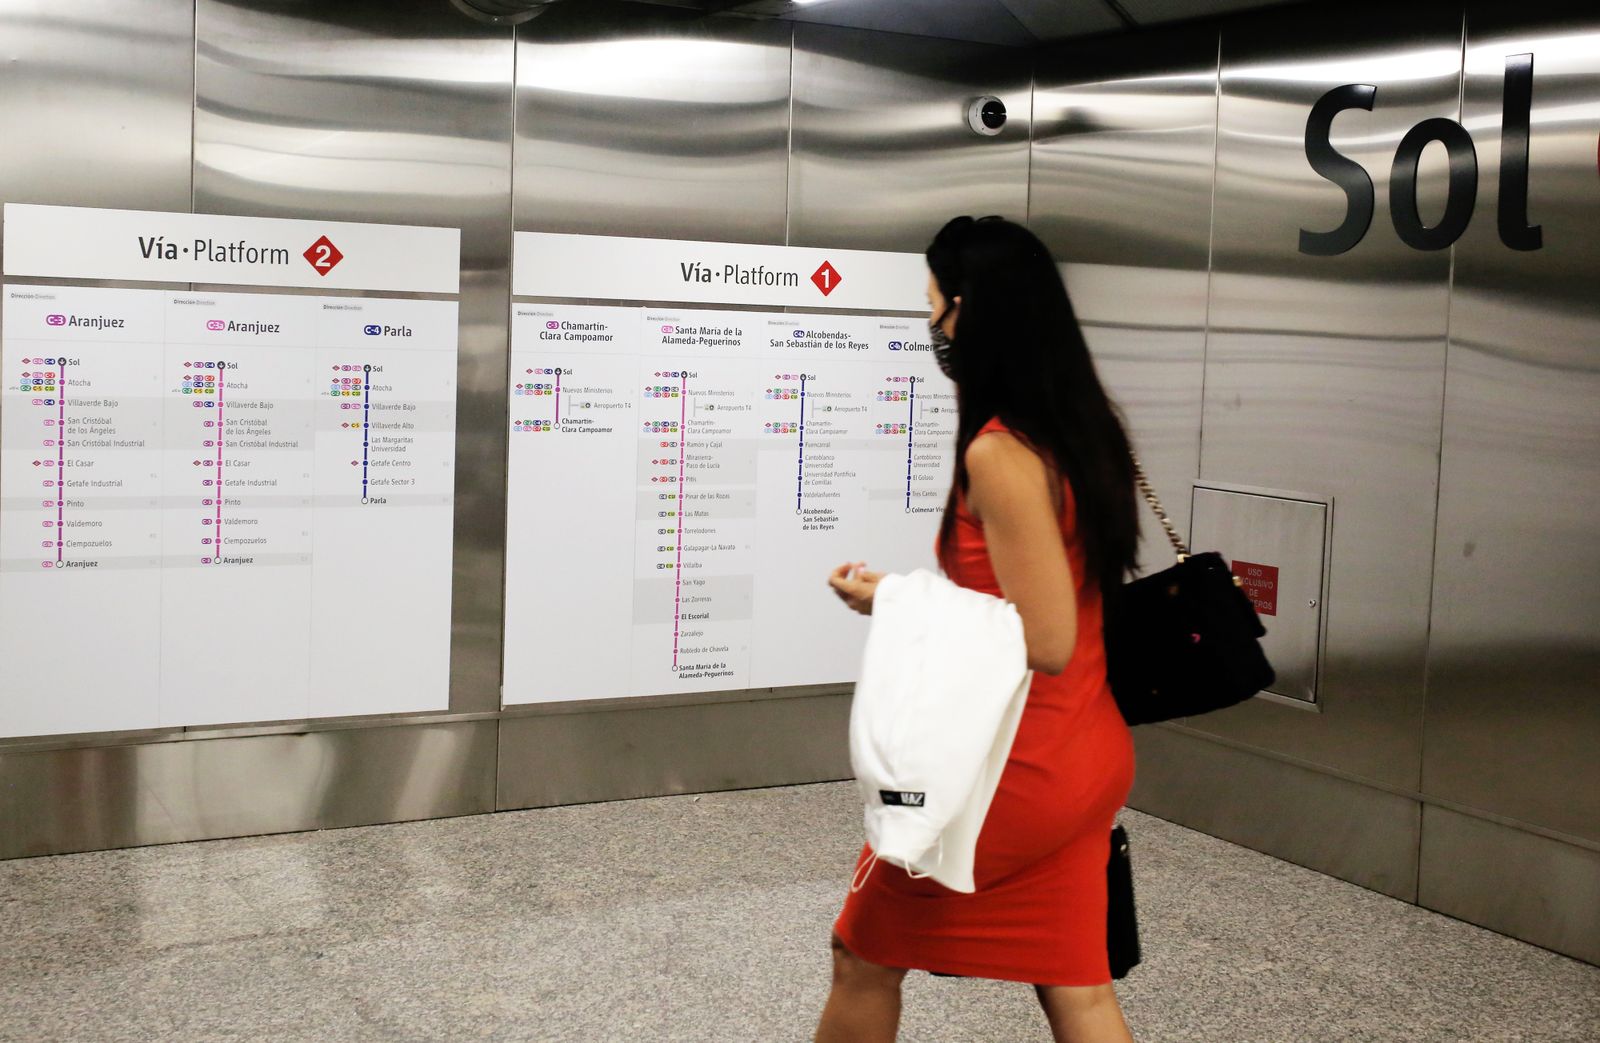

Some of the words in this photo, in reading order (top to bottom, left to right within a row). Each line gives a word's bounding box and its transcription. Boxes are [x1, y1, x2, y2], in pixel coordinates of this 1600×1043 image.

[1299, 53, 1543, 256] Sol
[194, 239, 290, 265] Platform
[316, 245, 332, 267] 2
[724, 266, 799, 287] Platform
[820, 269, 831, 288] 1
[69, 315, 124, 330] Aranjuez
[227, 320, 280, 335] Aranjuez
[384, 326, 412, 337] Parla
[675, 326, 697, 335] Santa
[723, 327, 733, 336] de
[735, 327, 742, 336] la
[540, 331, 561, 340] Clara
[564, 332, 613, 343] Campoamor
[806, 331, 851, 339] Alcobendas-
[662, 336, 741, 347] Alameda-Peguerinos
[770, 339, 784, 348] San
[786, 340, 822, 348] Sebastián
[824, 340, 833, 349] de
[835, 341, 846, 349] los
[848, 341, 869, 351] Reyes
[904, 342, 934, 351] Colmen
[68, 379, 91, 387] Atocha
[103, 400, 118, 408] Bajo
[260, 402, 274, 410] Bajo
[66, 540, 112, 548] Ciempozuelos
[224, 537, 267, 545] Ciempozuelos
[65, 560, 98, 568] Aranjuez
[223, 557, 253, 565] Aranjuez
[1248, 568, 1262, 577] USO
[1249, 588, 1259, 597] DE
[679, 671, 734, 679] Alameda-Peguerinos
